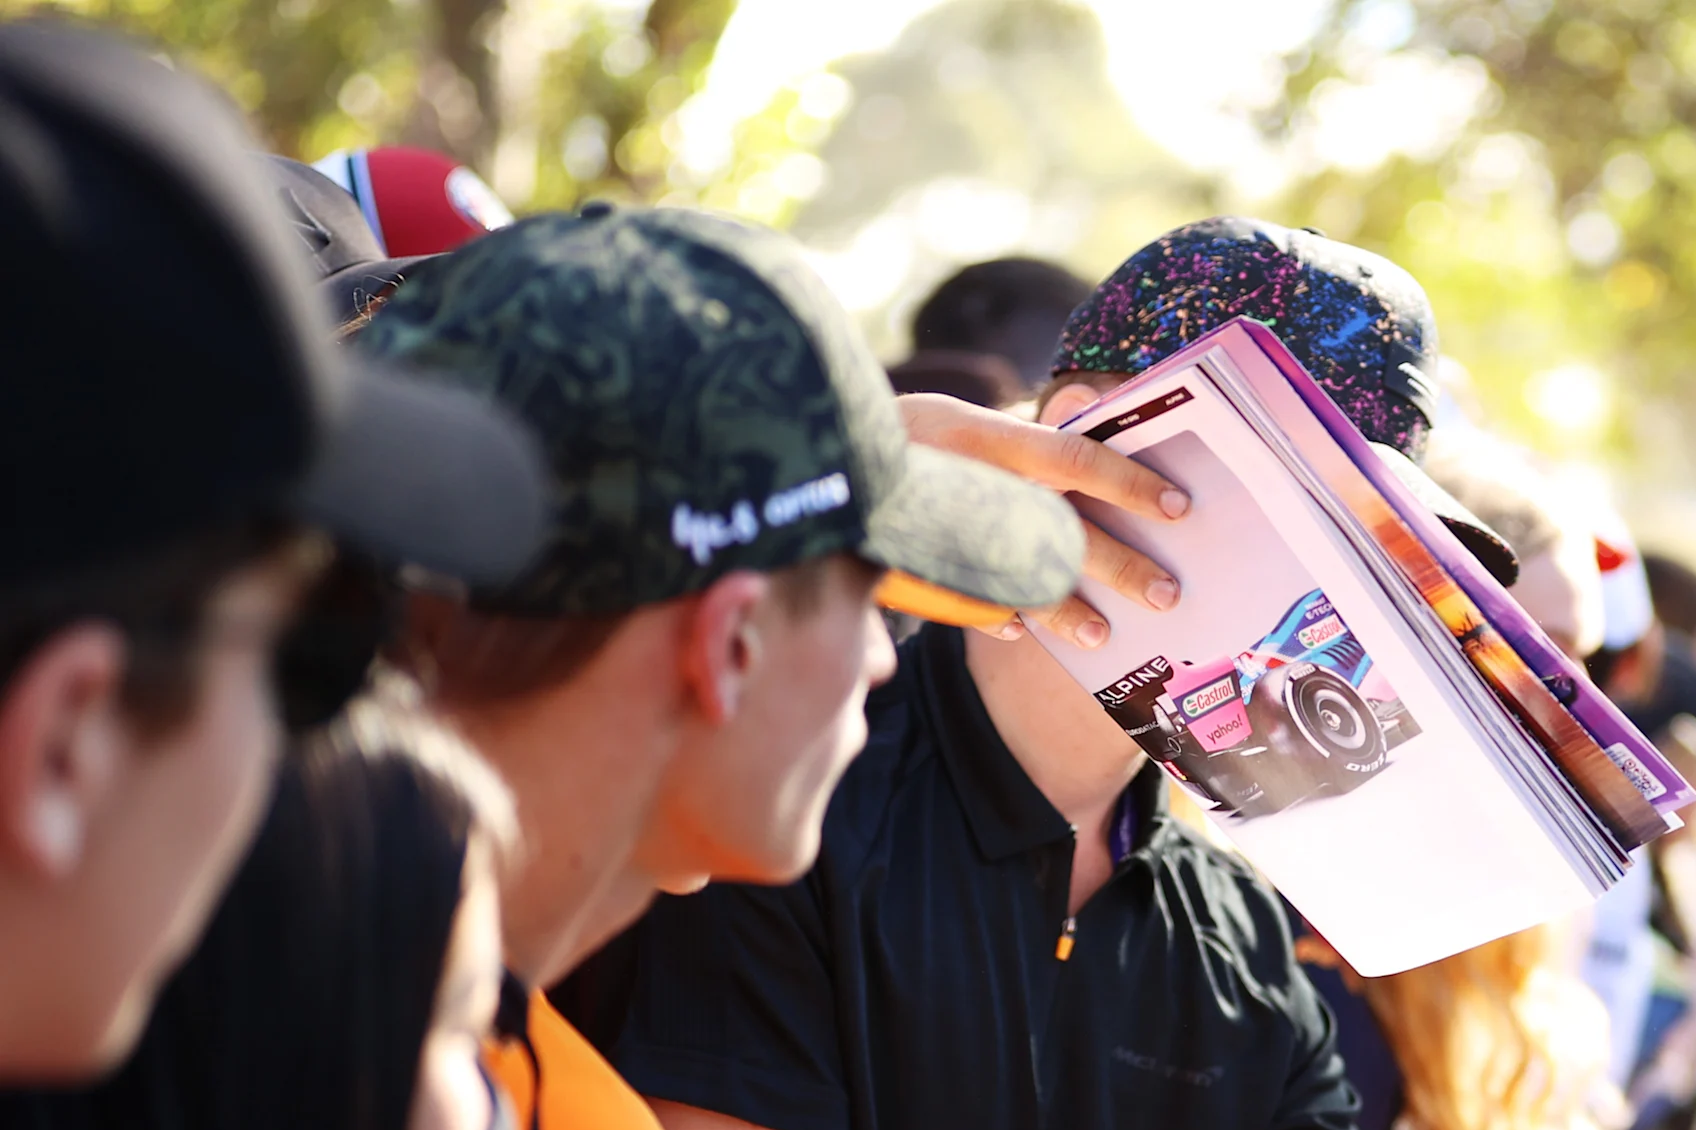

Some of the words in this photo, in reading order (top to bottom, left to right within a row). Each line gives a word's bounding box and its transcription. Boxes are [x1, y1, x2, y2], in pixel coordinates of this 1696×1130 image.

[1100, 656, 1171, 704] ALPINE
[1195, 678, 1235, 711] Castrol
[1206, 715, 1244, 746] yahoo!
